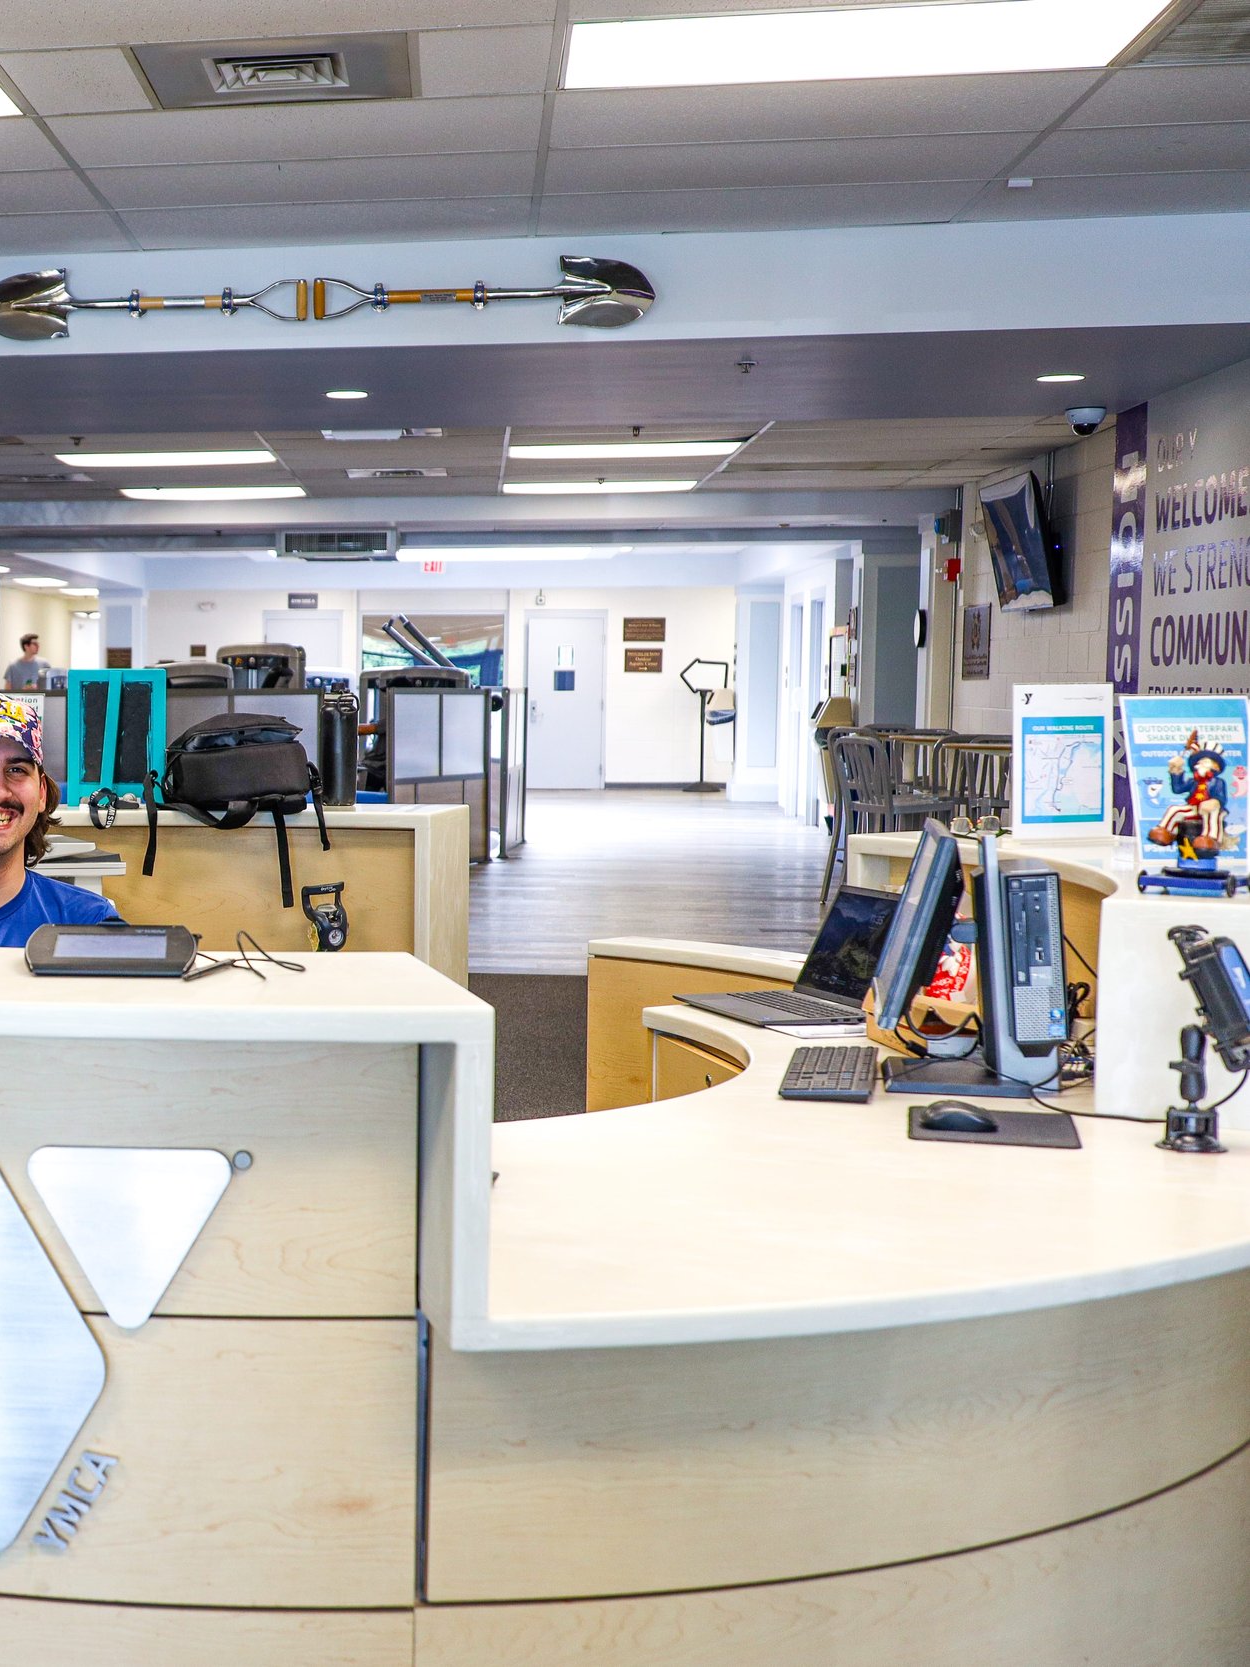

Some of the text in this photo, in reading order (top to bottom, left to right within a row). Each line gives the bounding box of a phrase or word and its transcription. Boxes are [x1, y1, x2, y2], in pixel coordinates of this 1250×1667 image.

[1157, 432, 1184, 473] OUR
[1156, 465, 1250, 533] WELCOME
[1153, 550, 1178, 596] WE
[1150, 610, 1250, 666] COMMUN
[33, 1450, 119, 1552] YMCA
